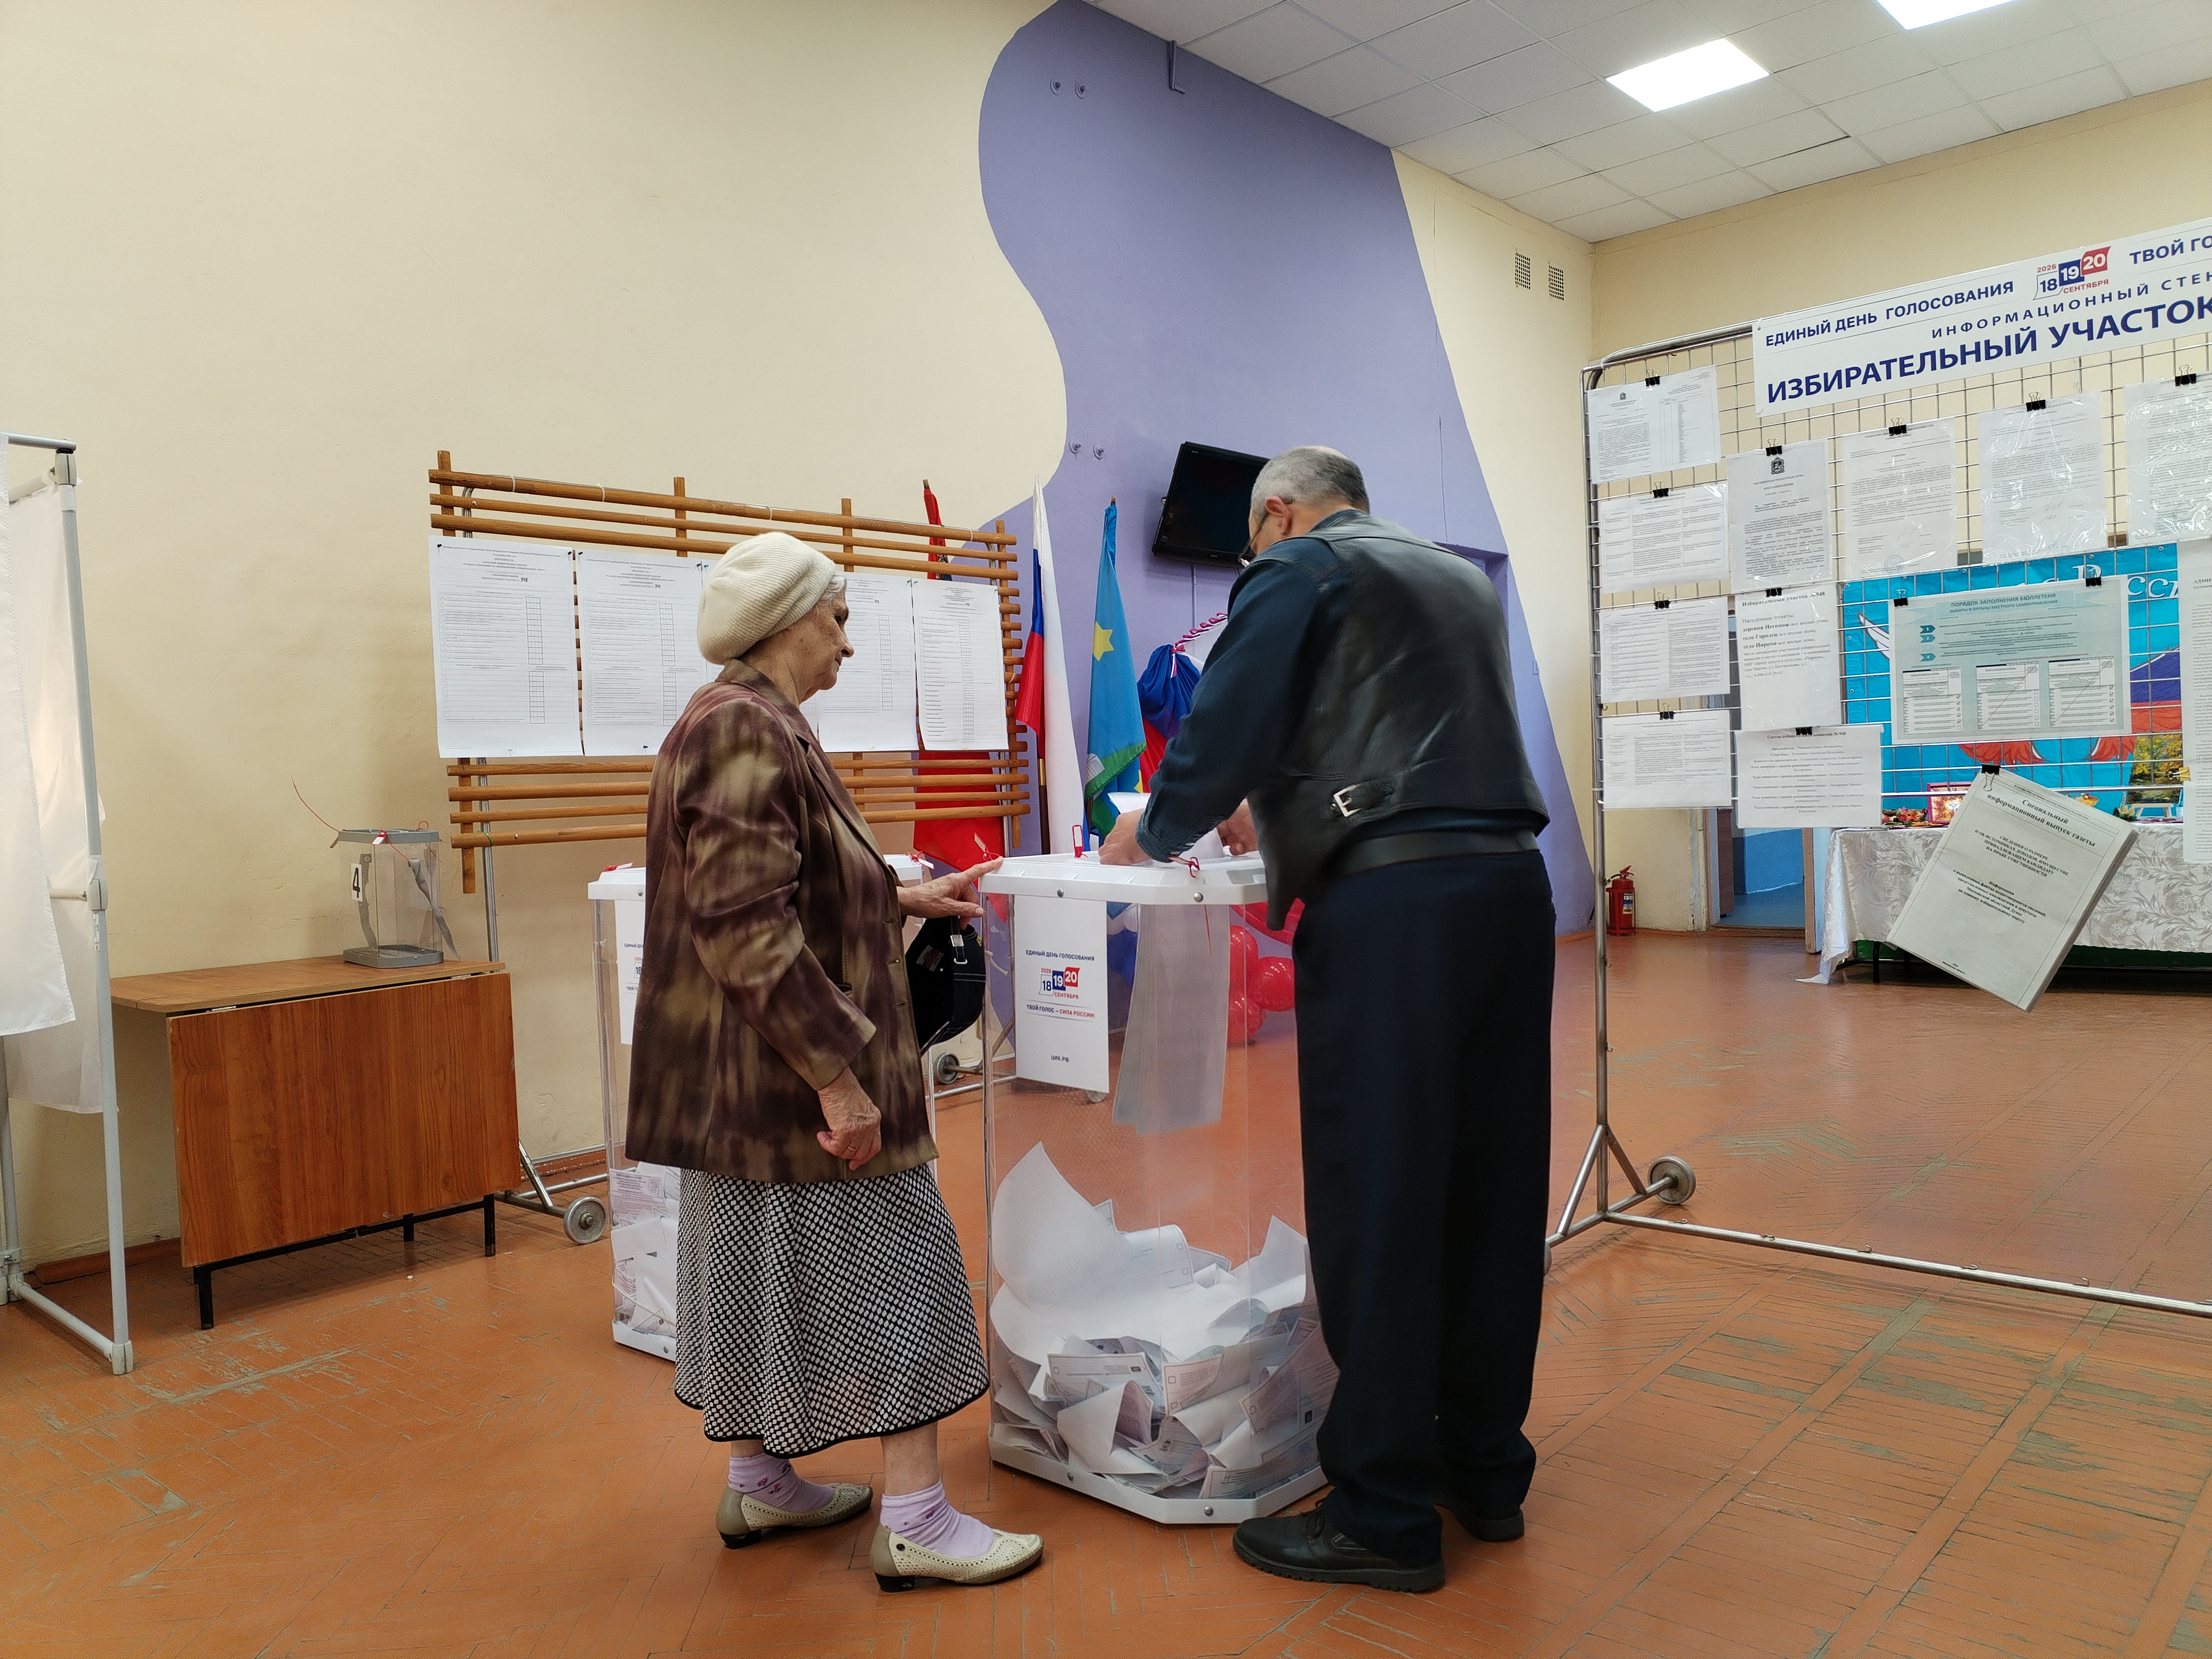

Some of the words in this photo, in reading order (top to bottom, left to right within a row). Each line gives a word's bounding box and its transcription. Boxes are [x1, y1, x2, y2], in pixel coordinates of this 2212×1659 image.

[2129, 239, 2183, 264] ТВОЙ
[2037, 264, 2056, 273] 2026
[2040, 278, 2057, 292] 18
[2061, 265, 2079, 281] 19
[2083, 253, 2105, 270] 20
[2064, 279, 2109, 294] СЕНТЯБРЯ
[1766, 320, 1830, 346] ЕДИНЫЙ
[1835, 313, 1876, 333] ДЕНЬ
[1886, 281, 2013, 320] ГОЛОСОВАНИЯ
[1932, 283, 2148, 338] ИНФОРМАЦИОННЫЙ
[1768, 326, 2036, 403] ИЗБИРАТЕЛЬНЫЙ
[2048, 296, 2212, 349] УЧАСТОК
[1980, 597, 2019, 605] ЗАПОЛНЕНИЯ
[1987, 794, 2045, 823] информационный
[2046, 821, 2071, 836] выпуск
[2073, 833, 2095, 847] газеты
[2022, 800, 2068, 824] Специальный
[1986, 835, 2015, 851] ИСТОЧНИКАХ
[2000, 836, 2024, 849] СВЕДЕНИЯ
[2029, 849, 2048, 861] РАЗМЕРЕ
[1984, 840, 2026, 861] ПРИНАДЛЕЖАЩЕМ
[2027, 860, 2054, 874] КАНДИДАТУ
[1993, 849, 2007, 858] ПРАВЕ
[2008, 856, 2047, 877] СОБСТВЕННОСТИ
[353, 867, 360, 898] 4
[1989, 881, 2014, 895] Информация
[1967, 887, 1990, 900] Московской
[1990, 899, 2010, 911] областной
[2010, 908, 2022, 916] Думы
[1042, 980, 1051, 991] 18
[1053, 975, 1063, 987] 19
[1065, 971, 1077, 983] 20
[1051, 1054, 1069, 1063] ЦИК.РФ
